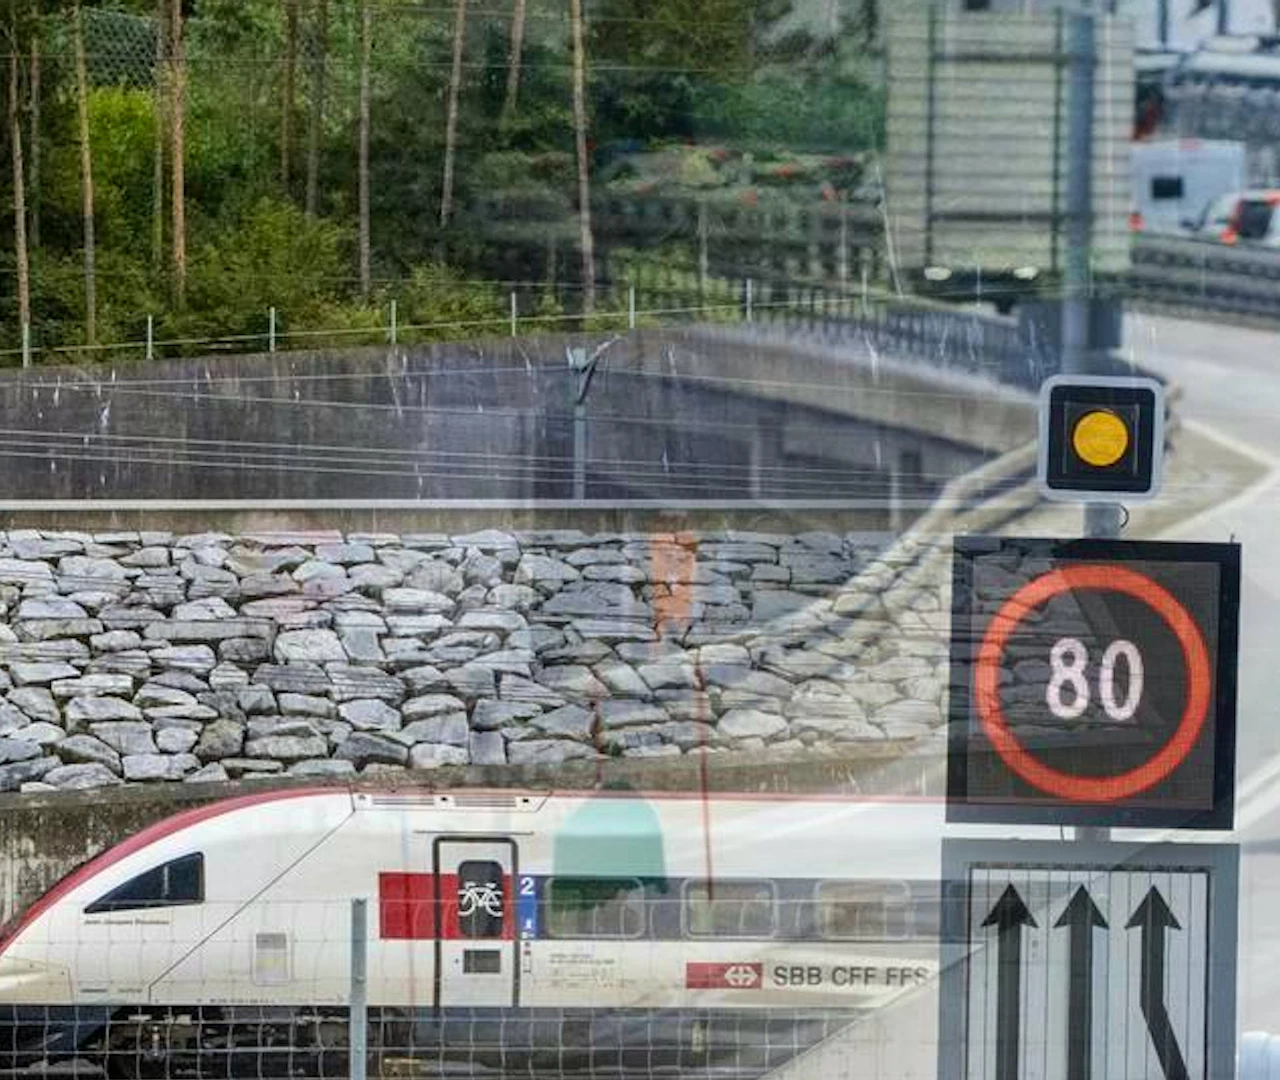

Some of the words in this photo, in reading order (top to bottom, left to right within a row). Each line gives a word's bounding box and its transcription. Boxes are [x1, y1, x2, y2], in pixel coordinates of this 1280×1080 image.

[1046, 637, 1144, 720] 80
[520, 877, 535, 895] 2
[773, 966, 822, 986] SBB
[831, 966, 877, 986] CFF
[886, 966, 932, 986] FFS
